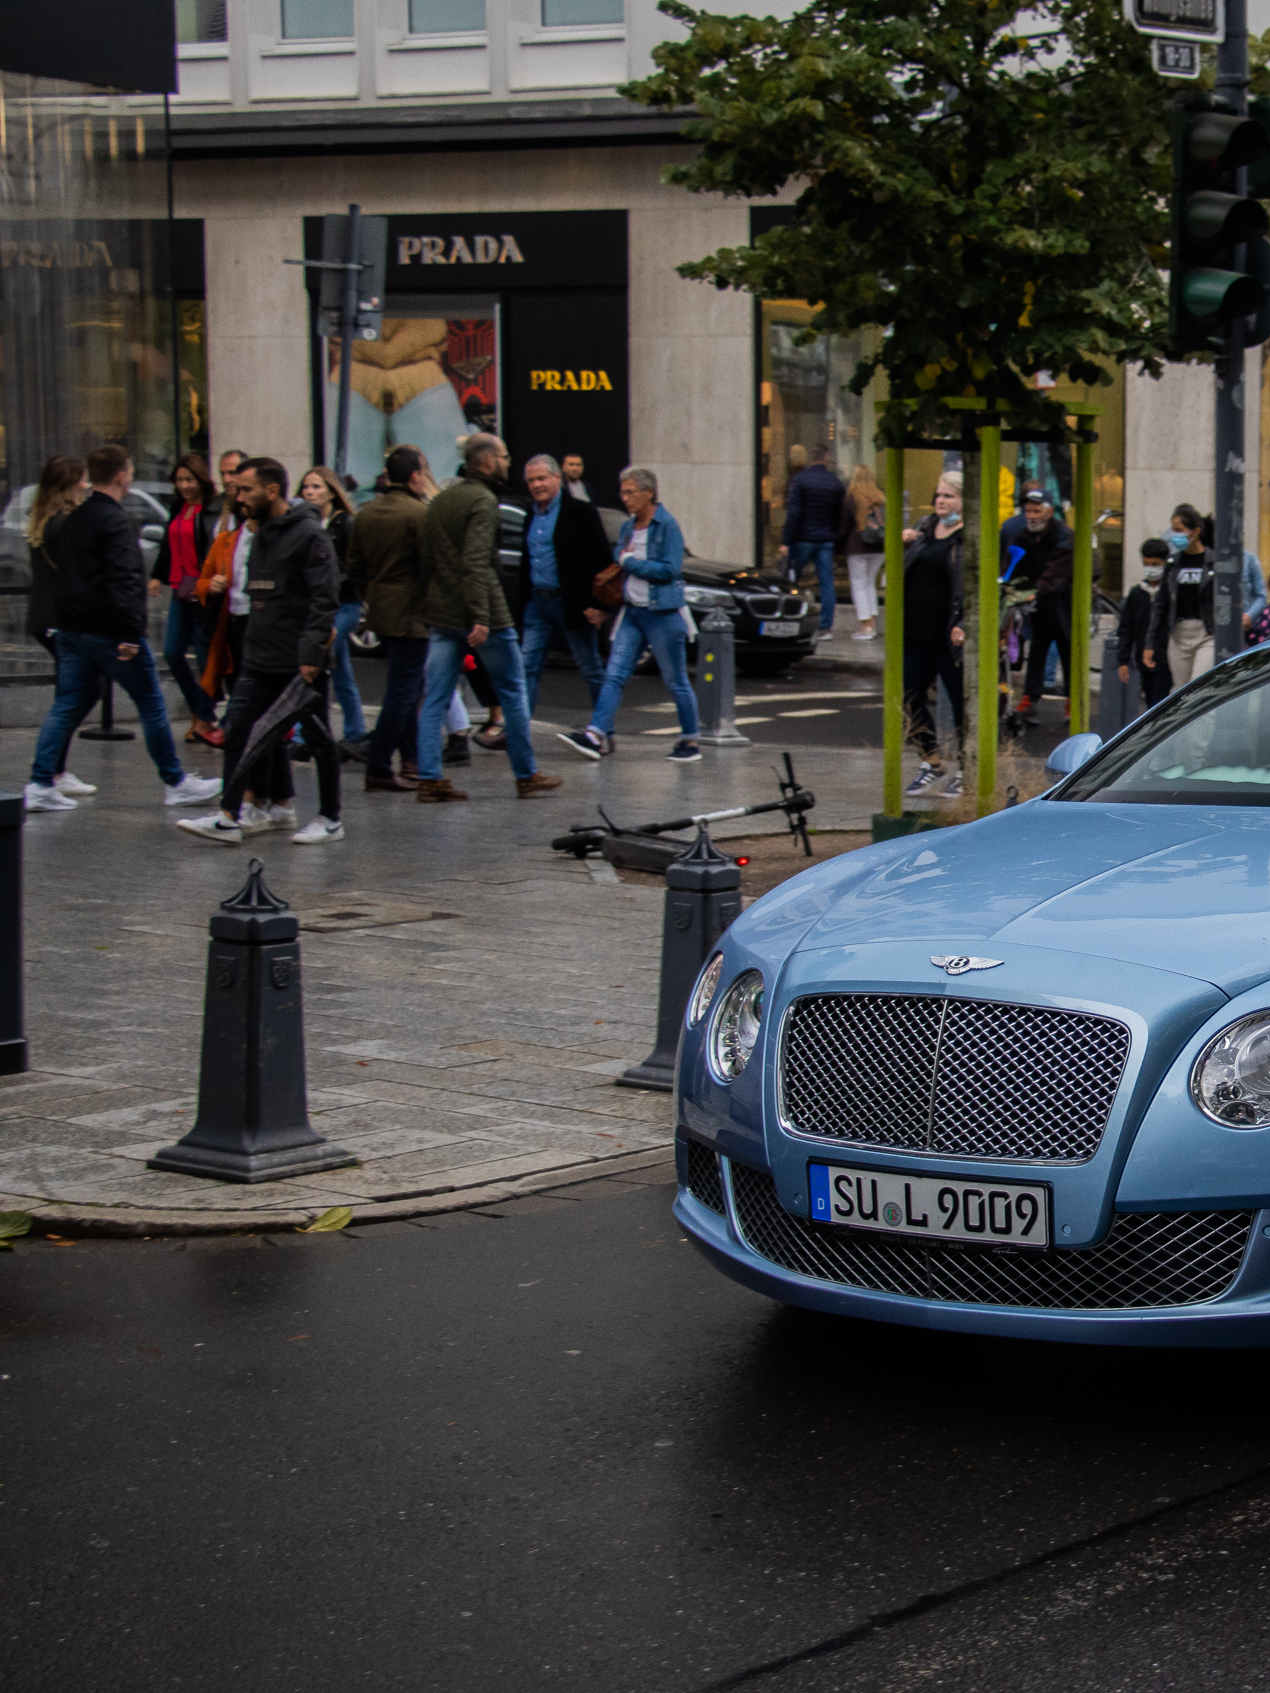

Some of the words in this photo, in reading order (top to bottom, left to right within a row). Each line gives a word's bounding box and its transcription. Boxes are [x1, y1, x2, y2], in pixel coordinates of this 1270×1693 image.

[398, 234, 525, 264] PRADA
[530, 370, 613, 391] PRADA
[817, 1197, 825, 1210] D
[834, 1174, 879, 1221] SU
[904, 1182, 929, 1227] L
[937, 1186, 1039, 1236] 9009
[907, 1238, 941, 1248] STUTTGART
